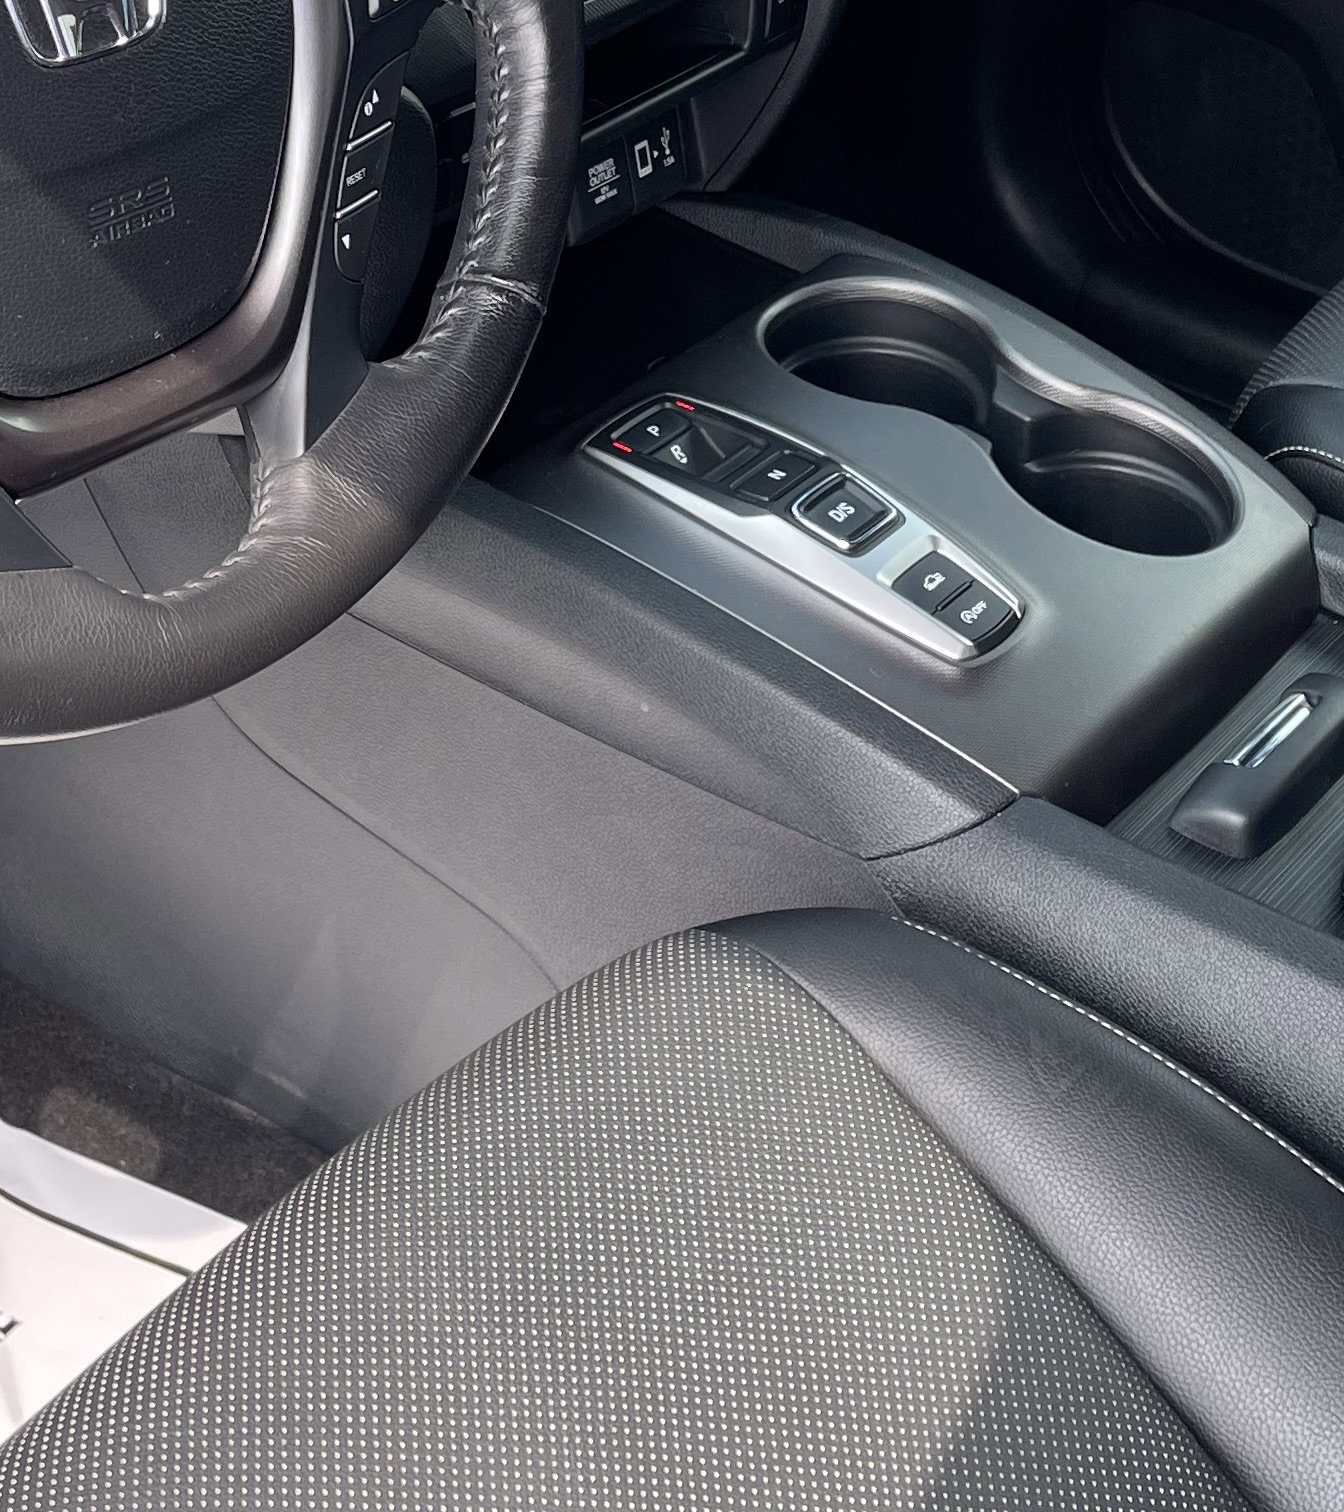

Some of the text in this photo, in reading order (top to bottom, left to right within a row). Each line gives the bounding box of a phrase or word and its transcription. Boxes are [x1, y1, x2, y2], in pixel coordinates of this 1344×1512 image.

[346, 167, 367, 187] RESET
[588, 157, 614, 178] POWER
[589, 167, 616, 187] OUTLET
[89, 203, 175, 248] AIRBAG
[647, 424, 660, 437] P
[670, 444, 685, 461] R
[767, 468, 787, 481] N
[828, 501, 855, 523] D/S
[972, 600, 988, 616] OFF
